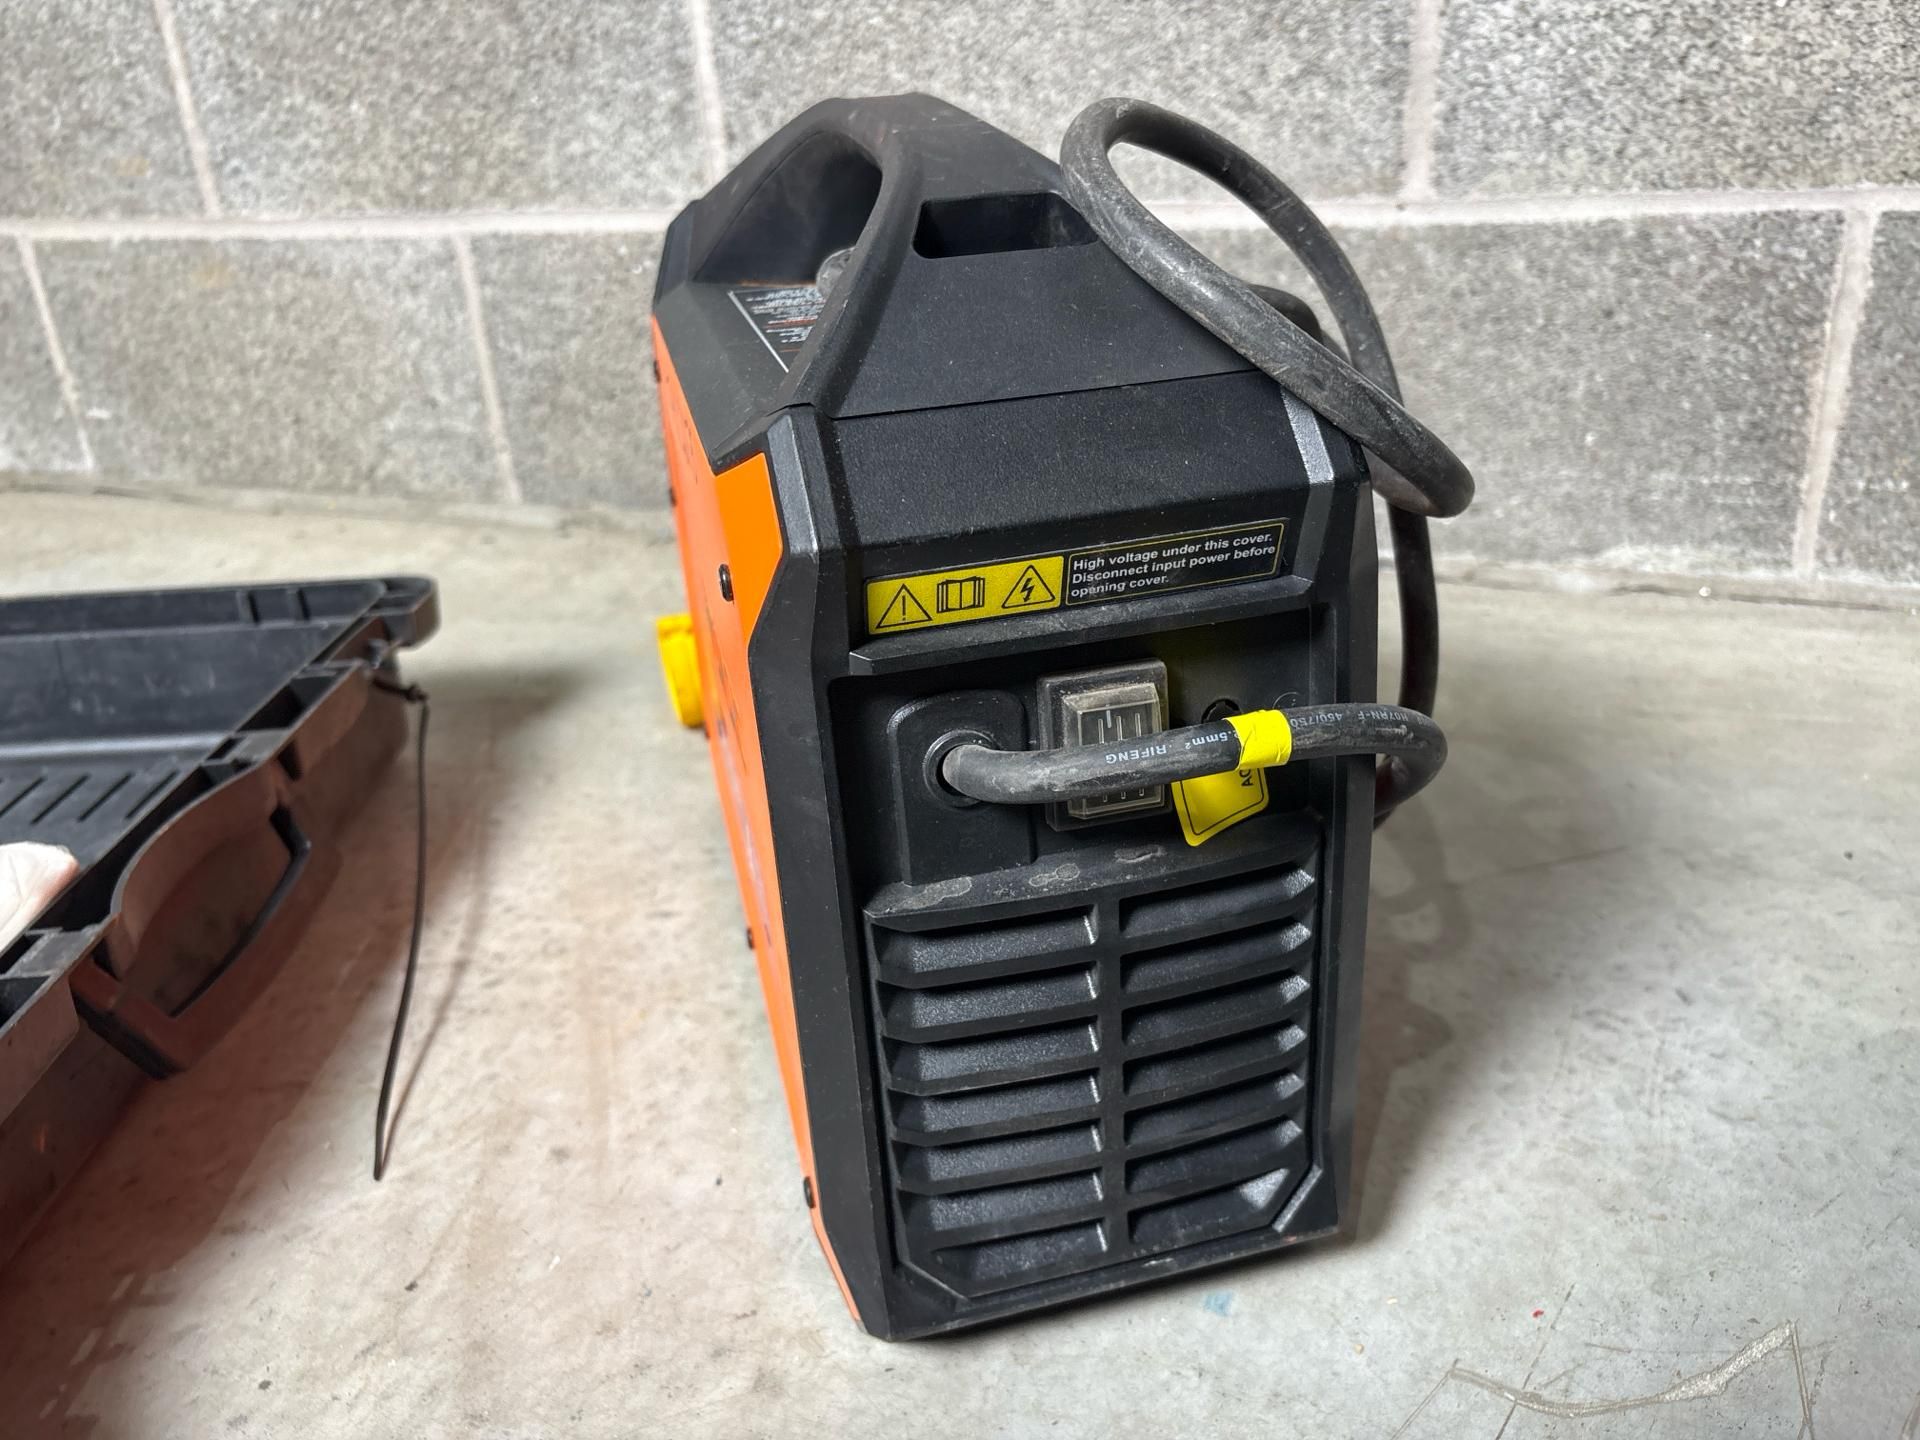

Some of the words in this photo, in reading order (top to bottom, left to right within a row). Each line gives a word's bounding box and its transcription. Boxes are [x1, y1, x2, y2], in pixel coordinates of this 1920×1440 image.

[1072, 563, 1149, 584] Disconnect
[1151, 557, 1186, 572] input
[1189, 552, 1231, 568] power
[1233, 545, 1275, 560] before
[1073, 557, 1105, 571] High
[1109, 552, 1158, 563] voltage
[1162, 544, 1201, 557] under
[1204, 539, 1230, 551] this
[1233, 533, 1273, 547] cover.
[1071, 582, 1126, 598] opening
[1129, 575, 1169, 588] cover.
[1105, 744, 1168, 764] RIFENG
